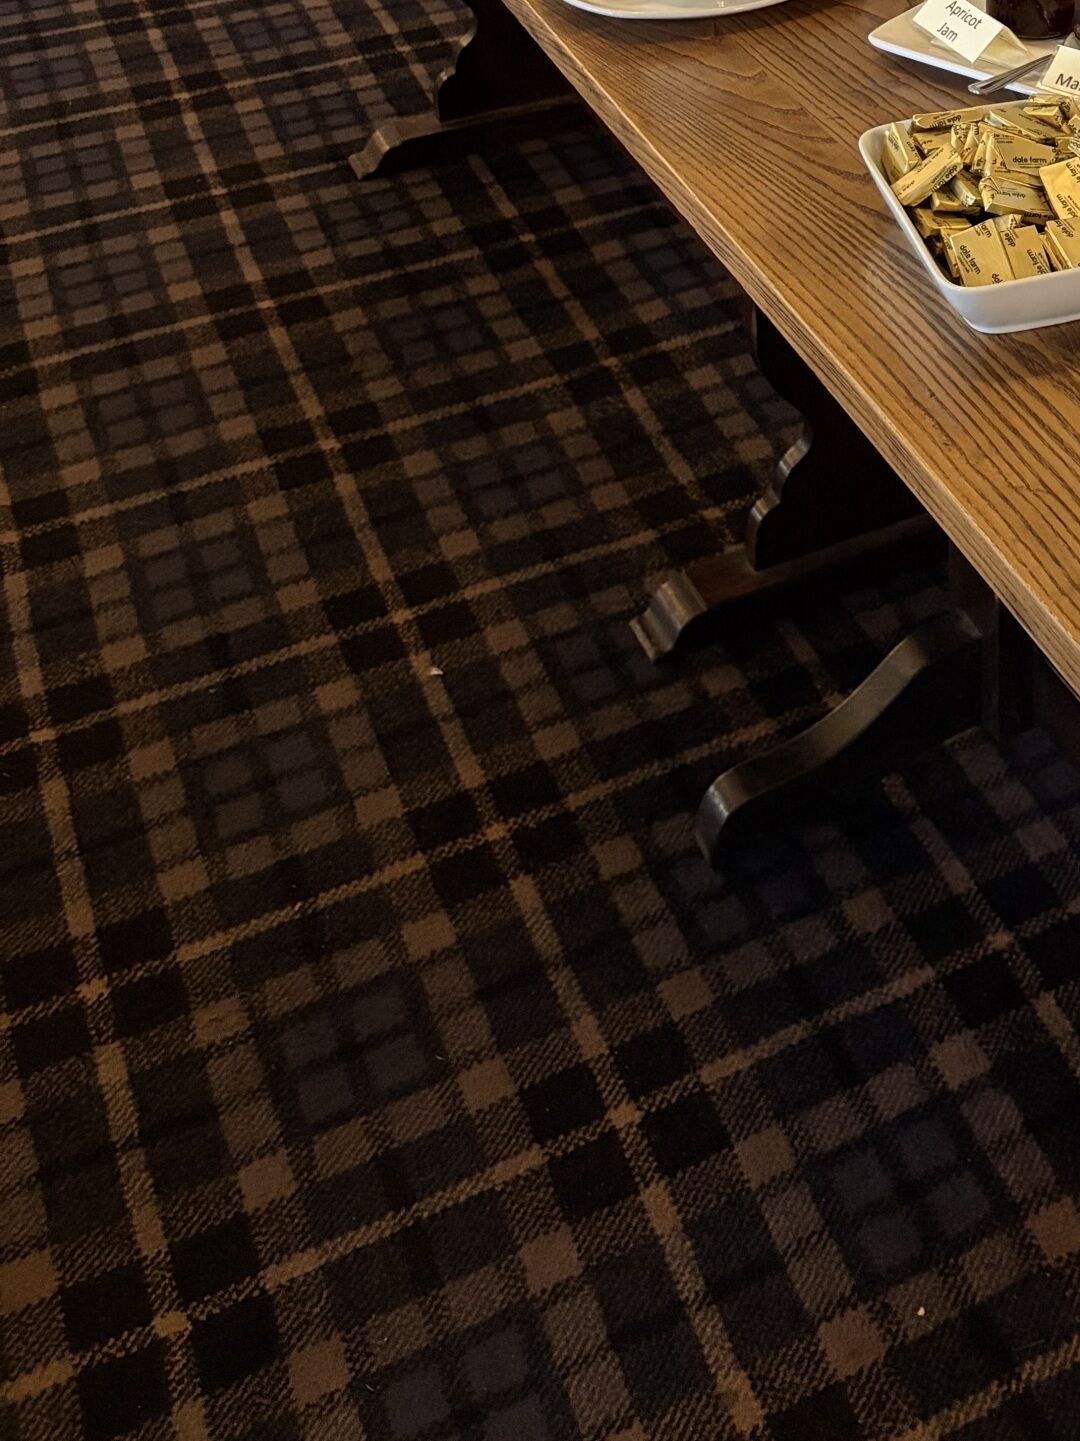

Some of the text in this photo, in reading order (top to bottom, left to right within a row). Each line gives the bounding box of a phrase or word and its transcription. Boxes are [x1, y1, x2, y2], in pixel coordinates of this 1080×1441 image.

[945, 0, 983, 30] Apricot
[936, 22, 958, 42] Jam
[1012, 156, 1047, 164] dale farm
[1065, 161, 1078, 178] farm
[1056, 193, 1070, 211] farm
[1004, 232, 1016, 247] dale
[1061, 226, 1074, 238] dale
[959, 244, 981, 275] dale farm
[1026, 248, 1039, 266] farm
